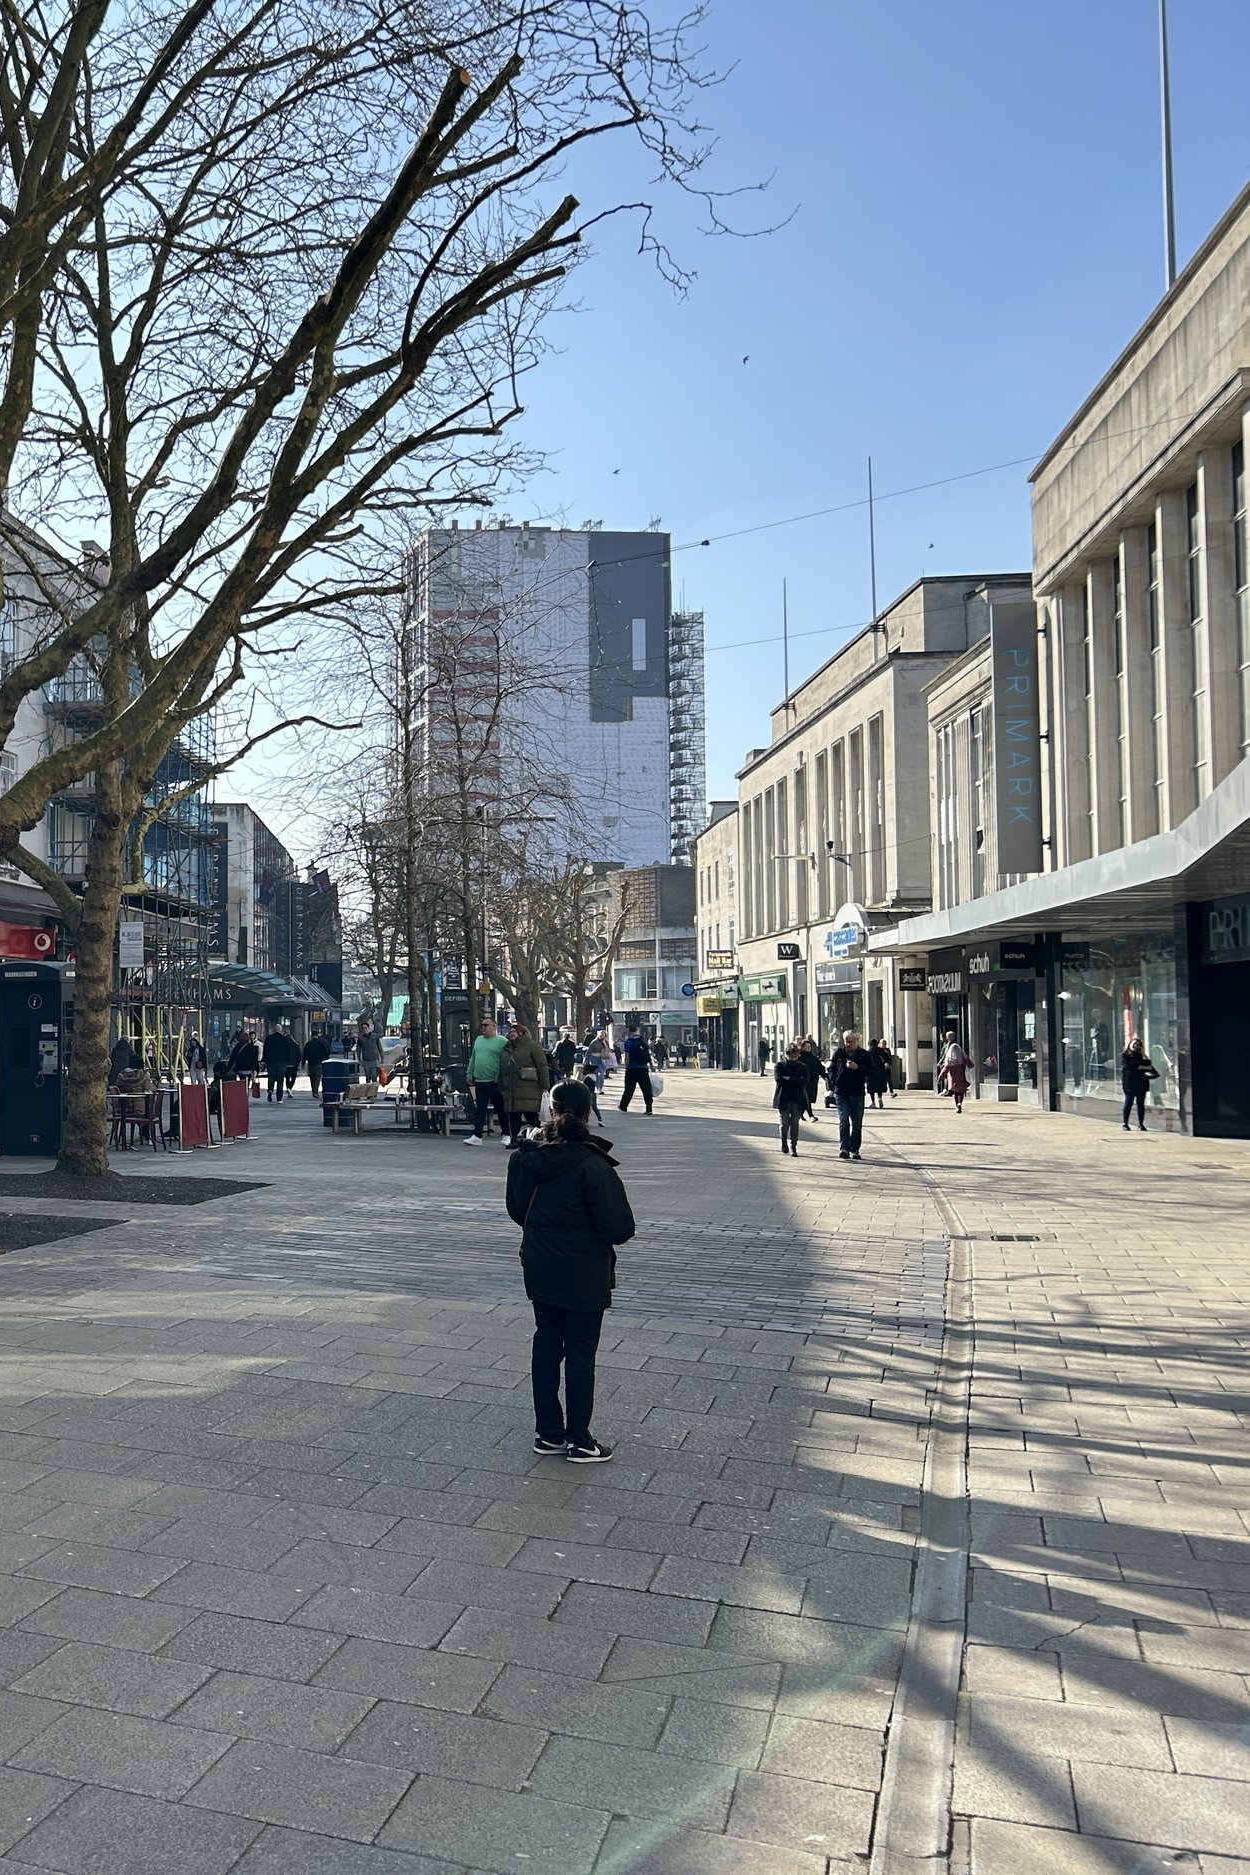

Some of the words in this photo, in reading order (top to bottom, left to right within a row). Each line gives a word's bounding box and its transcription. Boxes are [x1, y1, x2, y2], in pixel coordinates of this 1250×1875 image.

[1004, 649, 1033, 826] PRIMARK
[780, 945, 794, 955] W
[969, 951, 990, 974] schuh
